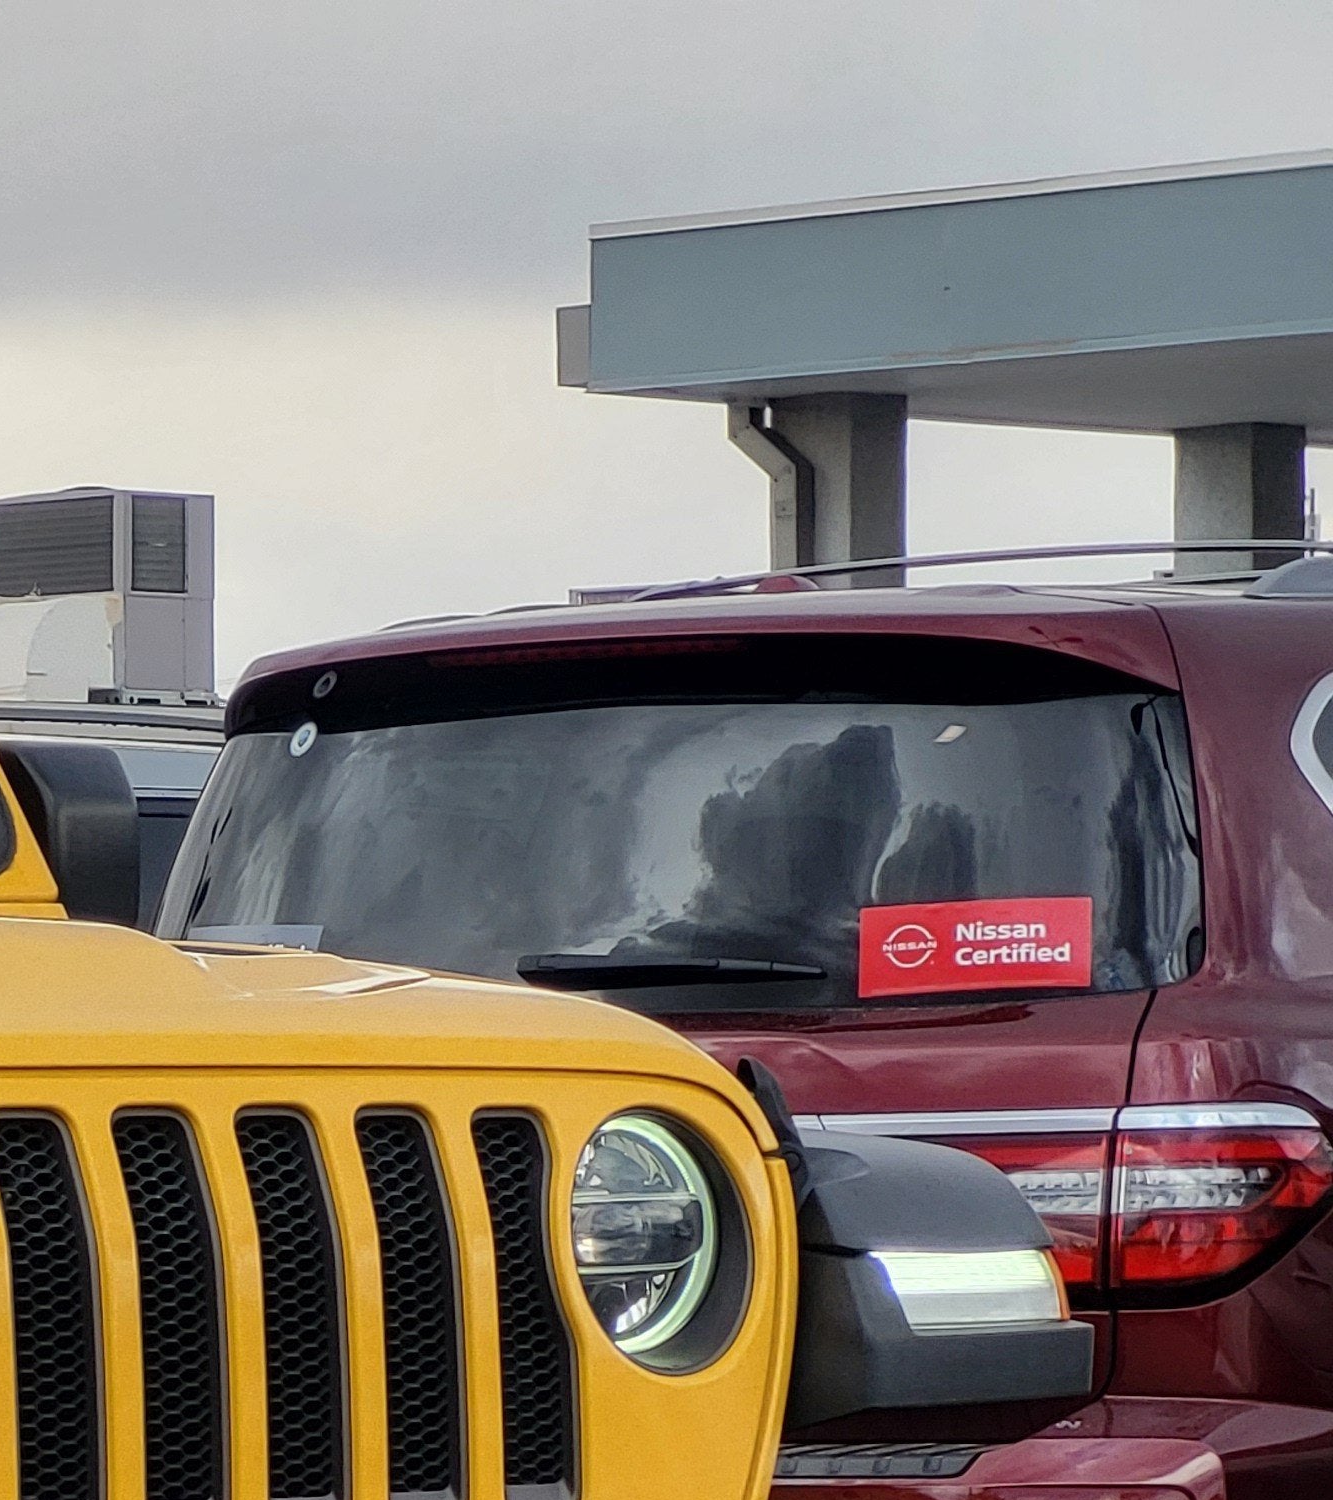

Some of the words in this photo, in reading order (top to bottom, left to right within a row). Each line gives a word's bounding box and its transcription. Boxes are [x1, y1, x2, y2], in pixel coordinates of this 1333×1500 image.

[955, 921, 1046, 942] Nissan
[882, 941, 937, 952] NISSAN
[954, 943, 1071, 966] Certified
